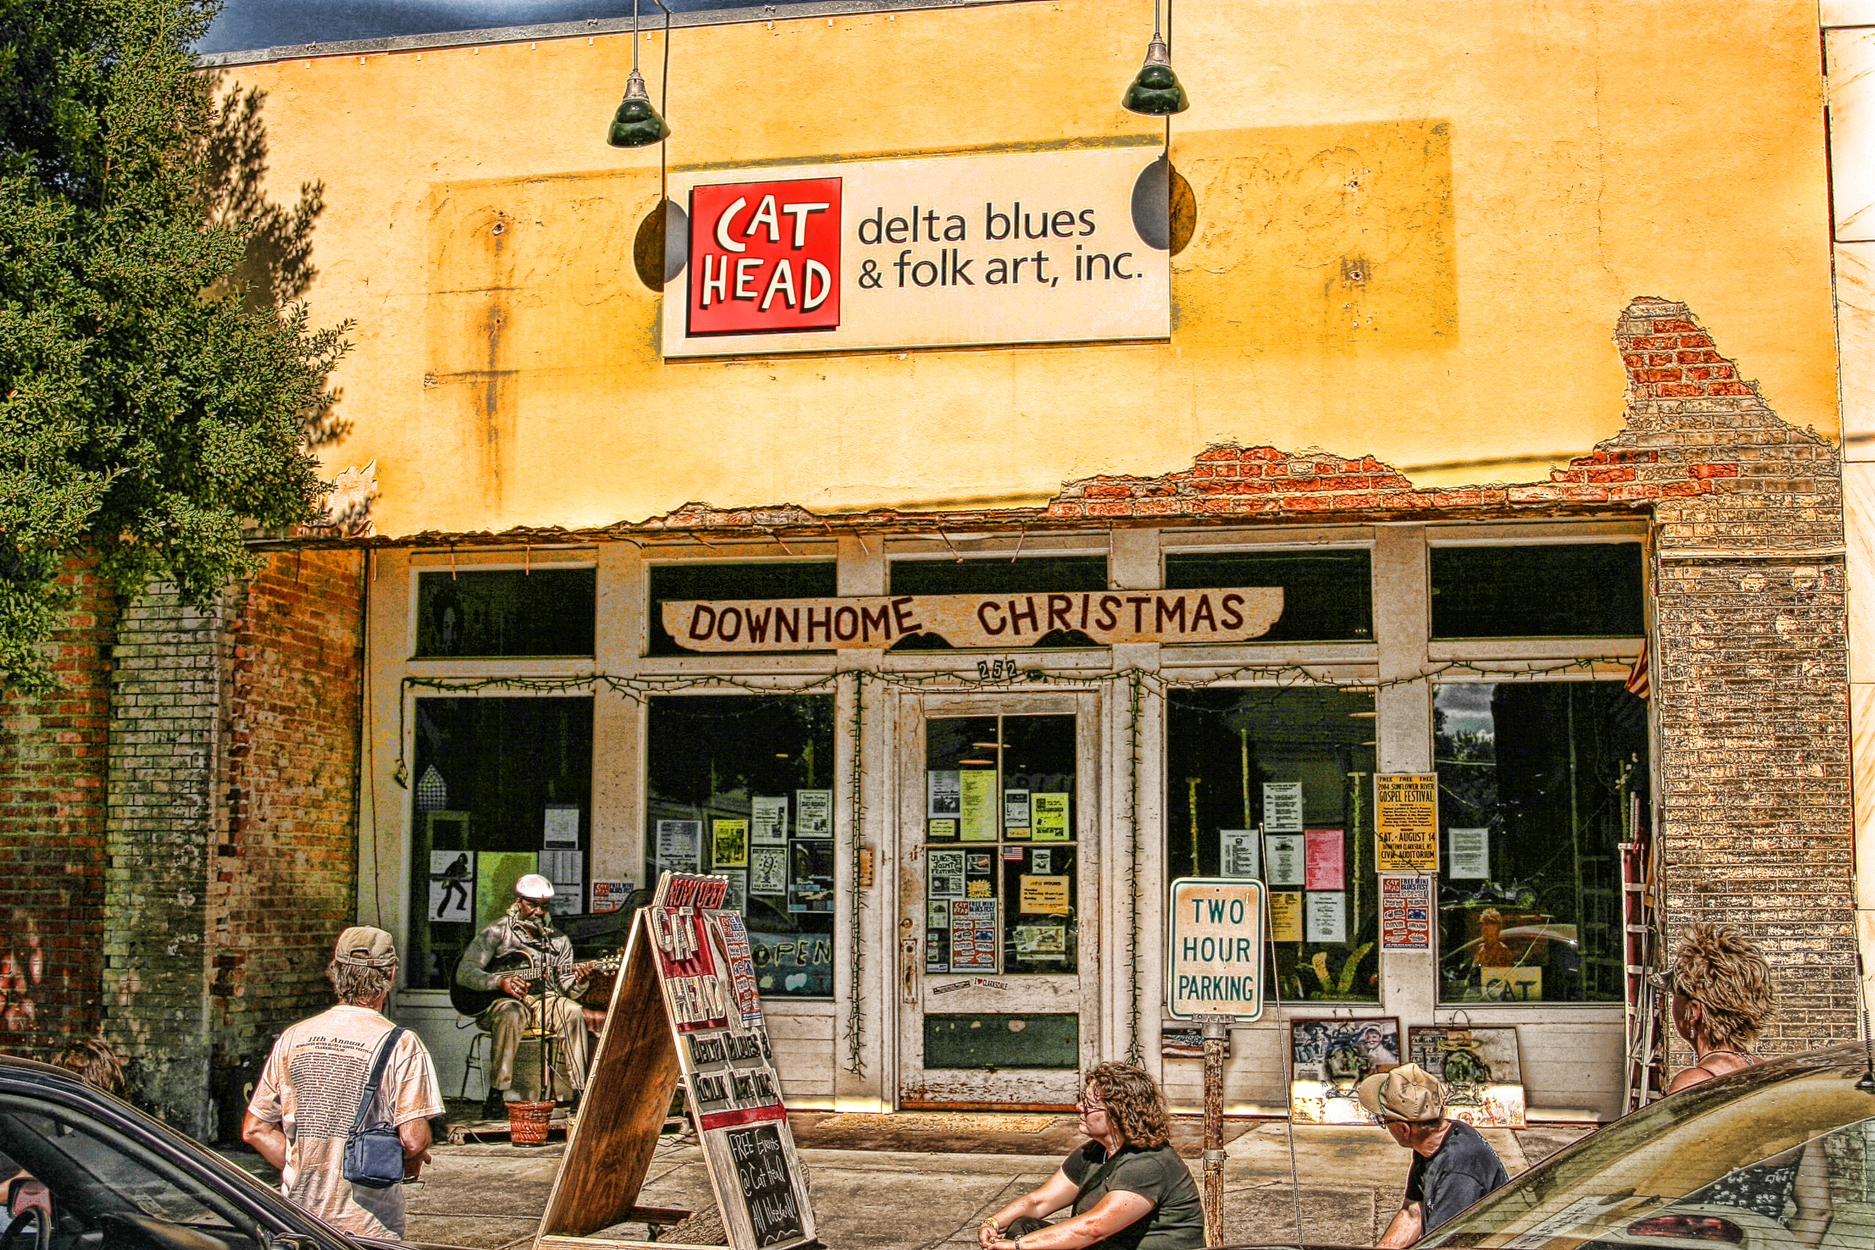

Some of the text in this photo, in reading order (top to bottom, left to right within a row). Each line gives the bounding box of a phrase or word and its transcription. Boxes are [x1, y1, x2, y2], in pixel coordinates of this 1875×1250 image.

[714, 195, 830, 252] CAT
[858, 201, 1095, 245] delta blues
[858, 244, 1143, 289] & folk art, inc.
[701, 254, 831, 313] HEAD
[689, 594, 1246, 643] DOWNHOME CHRISTMAS
[978, 661, 1016, 678] 252
[1379, 790, 1434, 802] GOSPEL FESTIVAL
[1399, 832, 1425, 841] AUGUST
[696, 881, 727, 909] OPEN
[1192, 899, 1244, 924] TWO
[652, 907, 698, 960] CAT
[752, 939, 831, 967] OPEN
[1182, 937, 1250, 962] HOUR
[666, 975, 726, 1024] HEAD
[1178, 975, 1254, 1001] PARKING
[1486, 978, 1537, 1001] CAT
[330, 1037, 366, 1048] Annual
[729, 1128, 780, 1162] FREE Events
[740, 1168, 752, 1197] @
[752, 1199, 767, 1236] All
